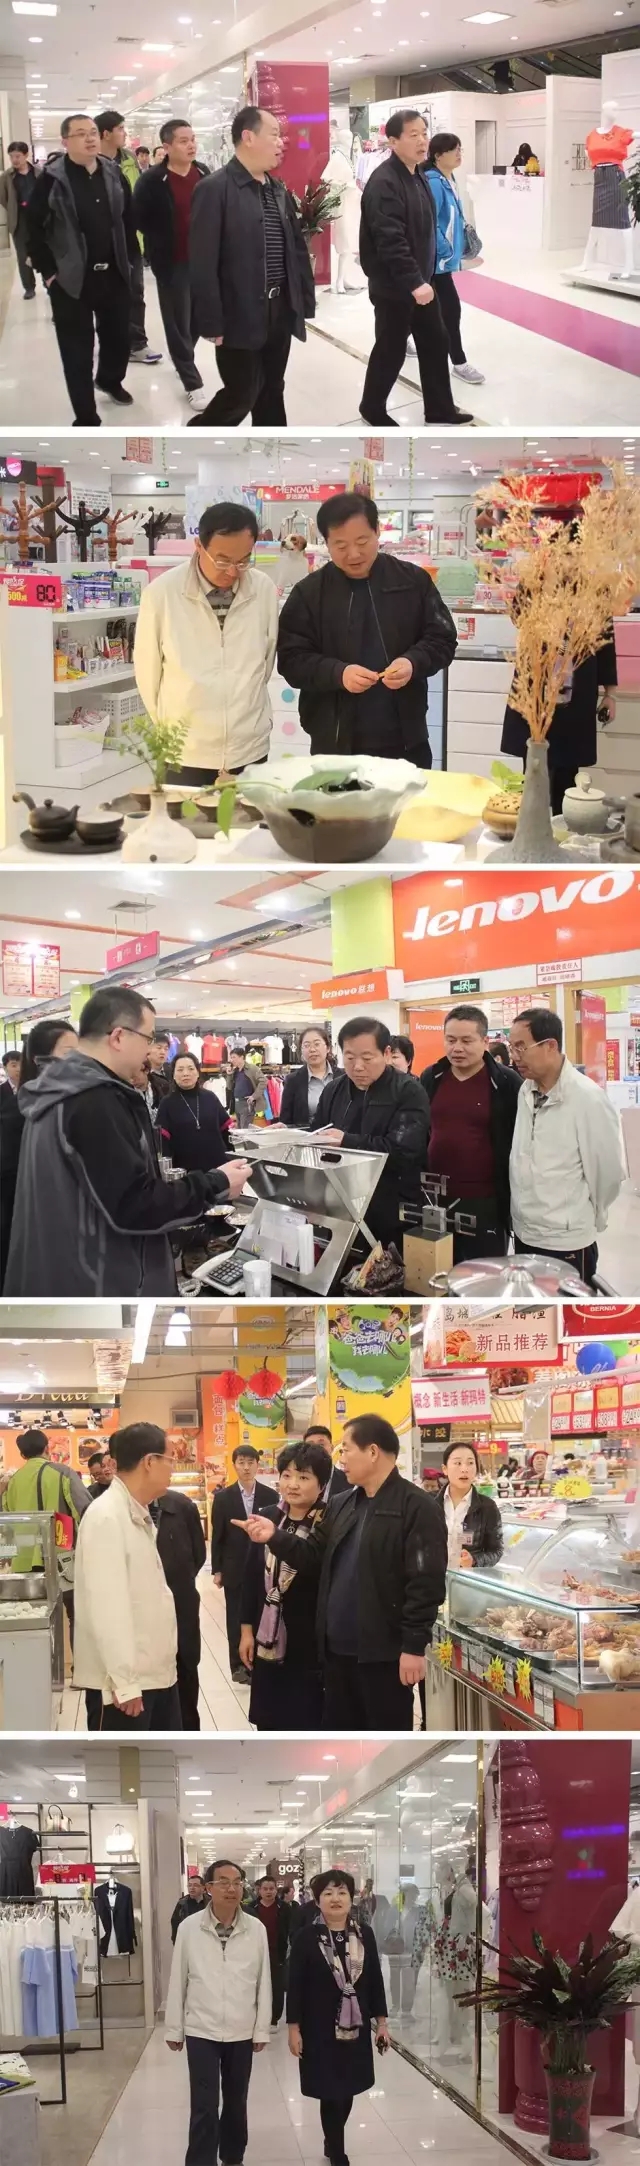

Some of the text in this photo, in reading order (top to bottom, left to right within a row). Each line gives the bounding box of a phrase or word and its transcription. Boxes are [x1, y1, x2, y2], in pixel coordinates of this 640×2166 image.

[275, 485, 320, 494] MENDALE
[36, 584, 56, 603] 80
[402, 870, 634, 941] lenovo
[415, 1022, 444, 1031] lenovo
[476, 1333, 549, 1353] 新品推荐
[433, 1391, 458, 1409] 新生活
[460, 1389, 486, 1408] 新玛特
